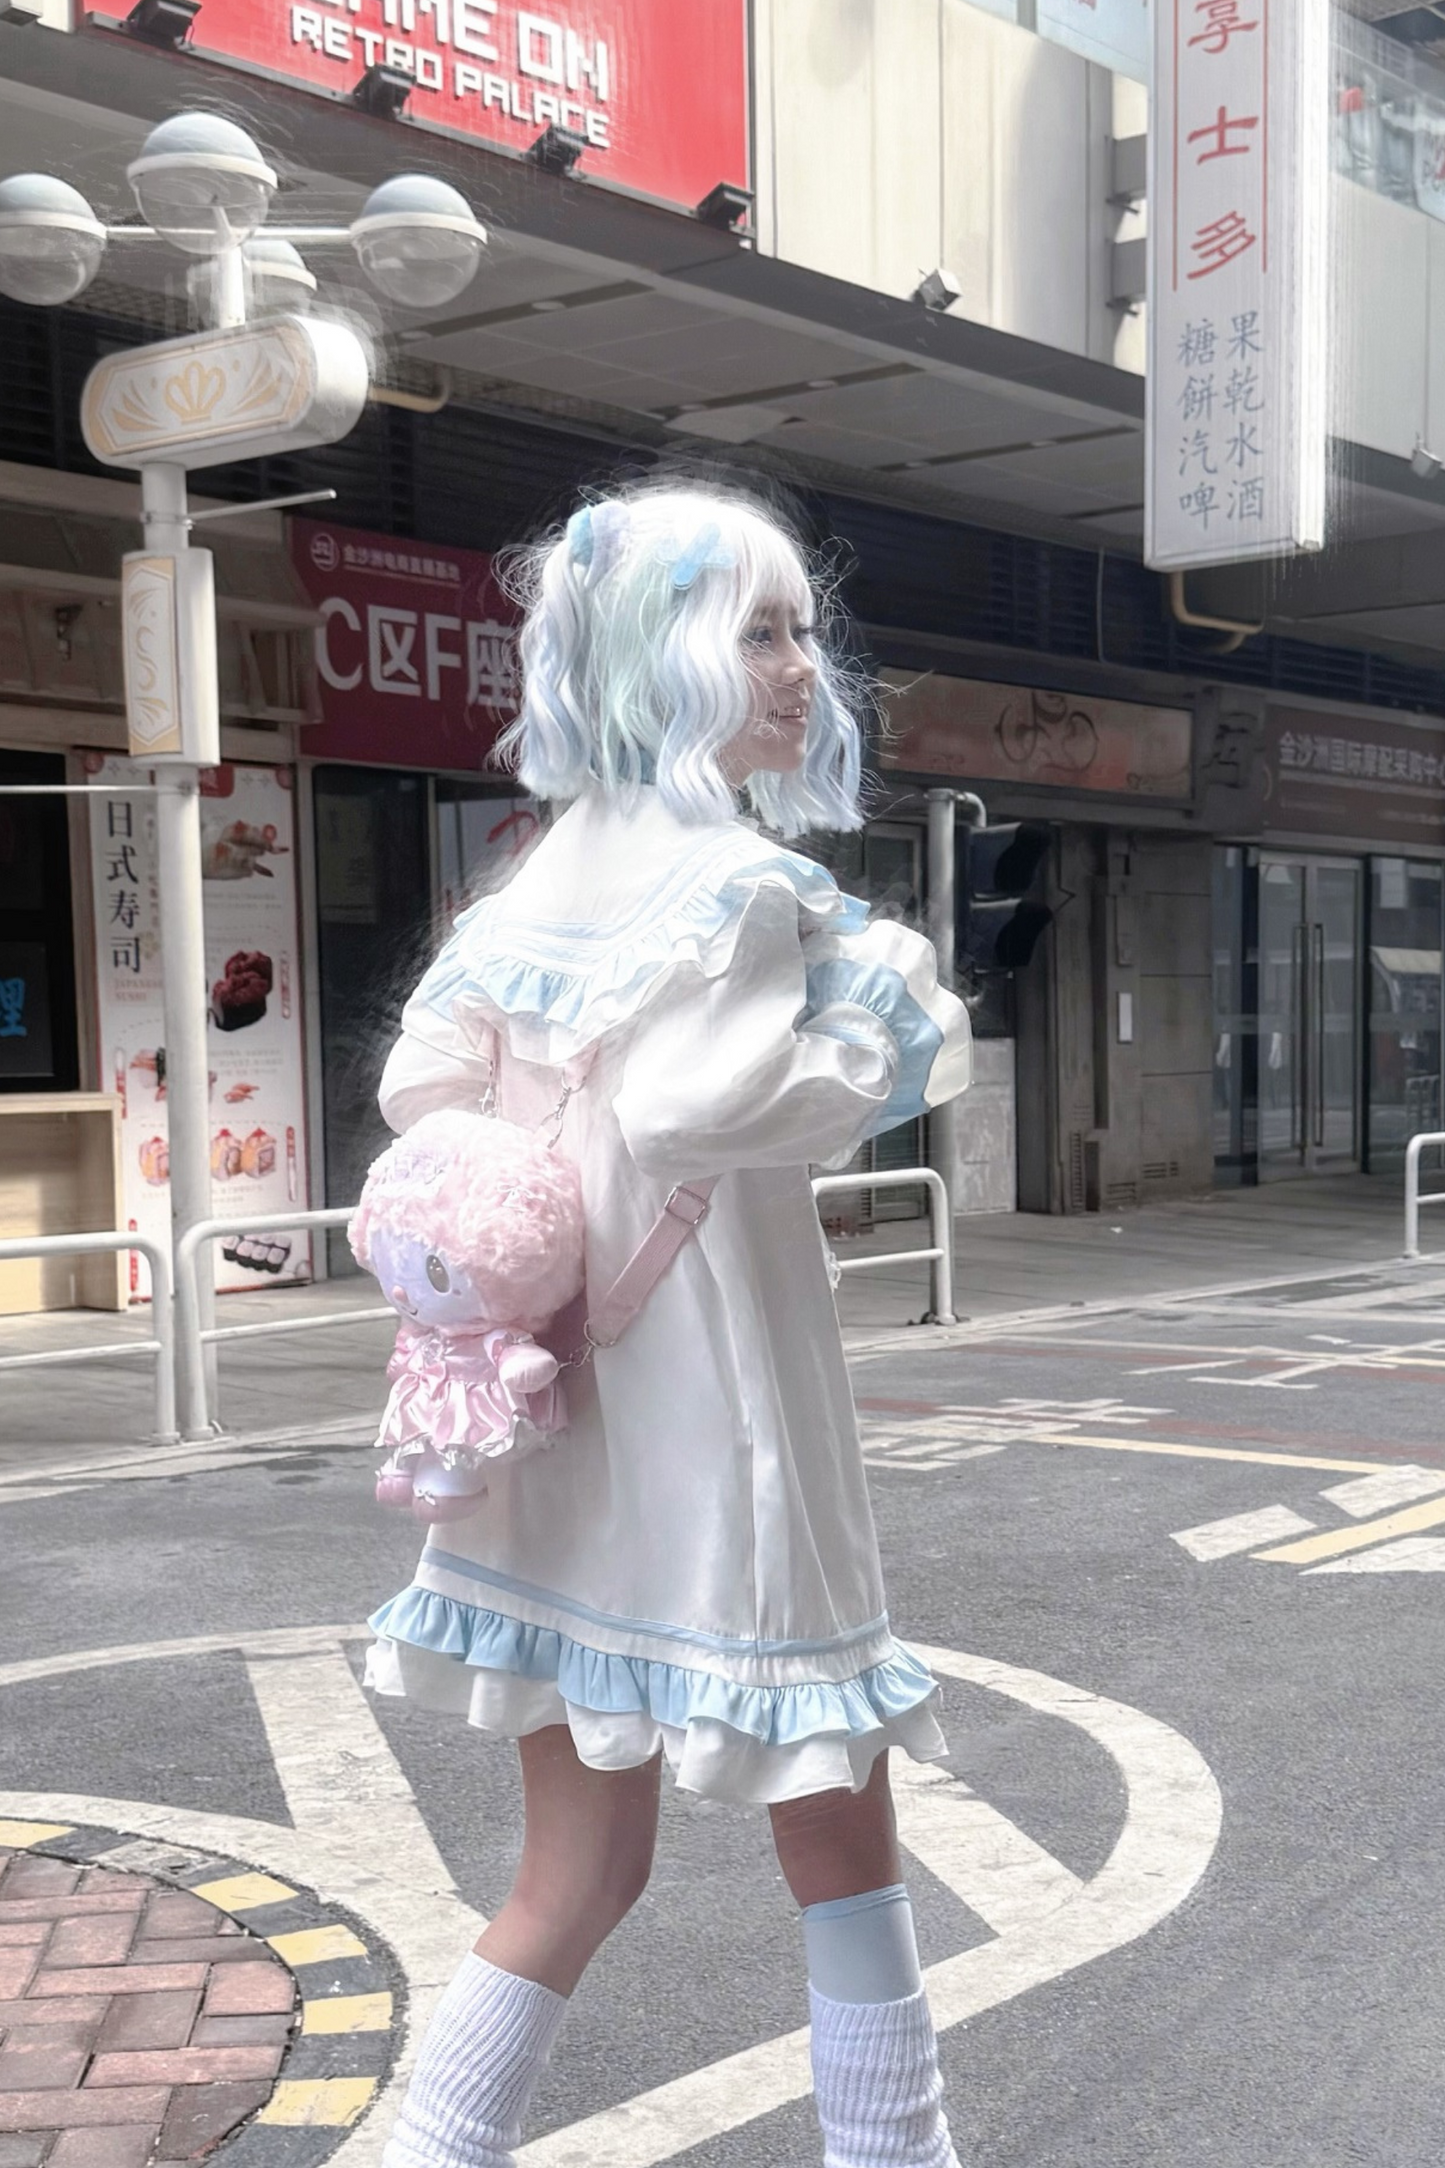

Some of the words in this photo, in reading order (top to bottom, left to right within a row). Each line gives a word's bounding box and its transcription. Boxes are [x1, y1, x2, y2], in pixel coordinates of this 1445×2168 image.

[292, 5, 443, 91] RETRO
[454, 62, 610, 148] PALACE
[517, 11, 608, 102] ON
[1177, 310, 1263, 368] 糖果
[1177, 366, 1265, 421] 餅乾
[1179, 421, 1264, 476] 汽水
[1179, 477, 1265, 531] 啤酒
[315, 597, 519, 711] C区F座
[106, 801, 140, 973] 日式寿司
